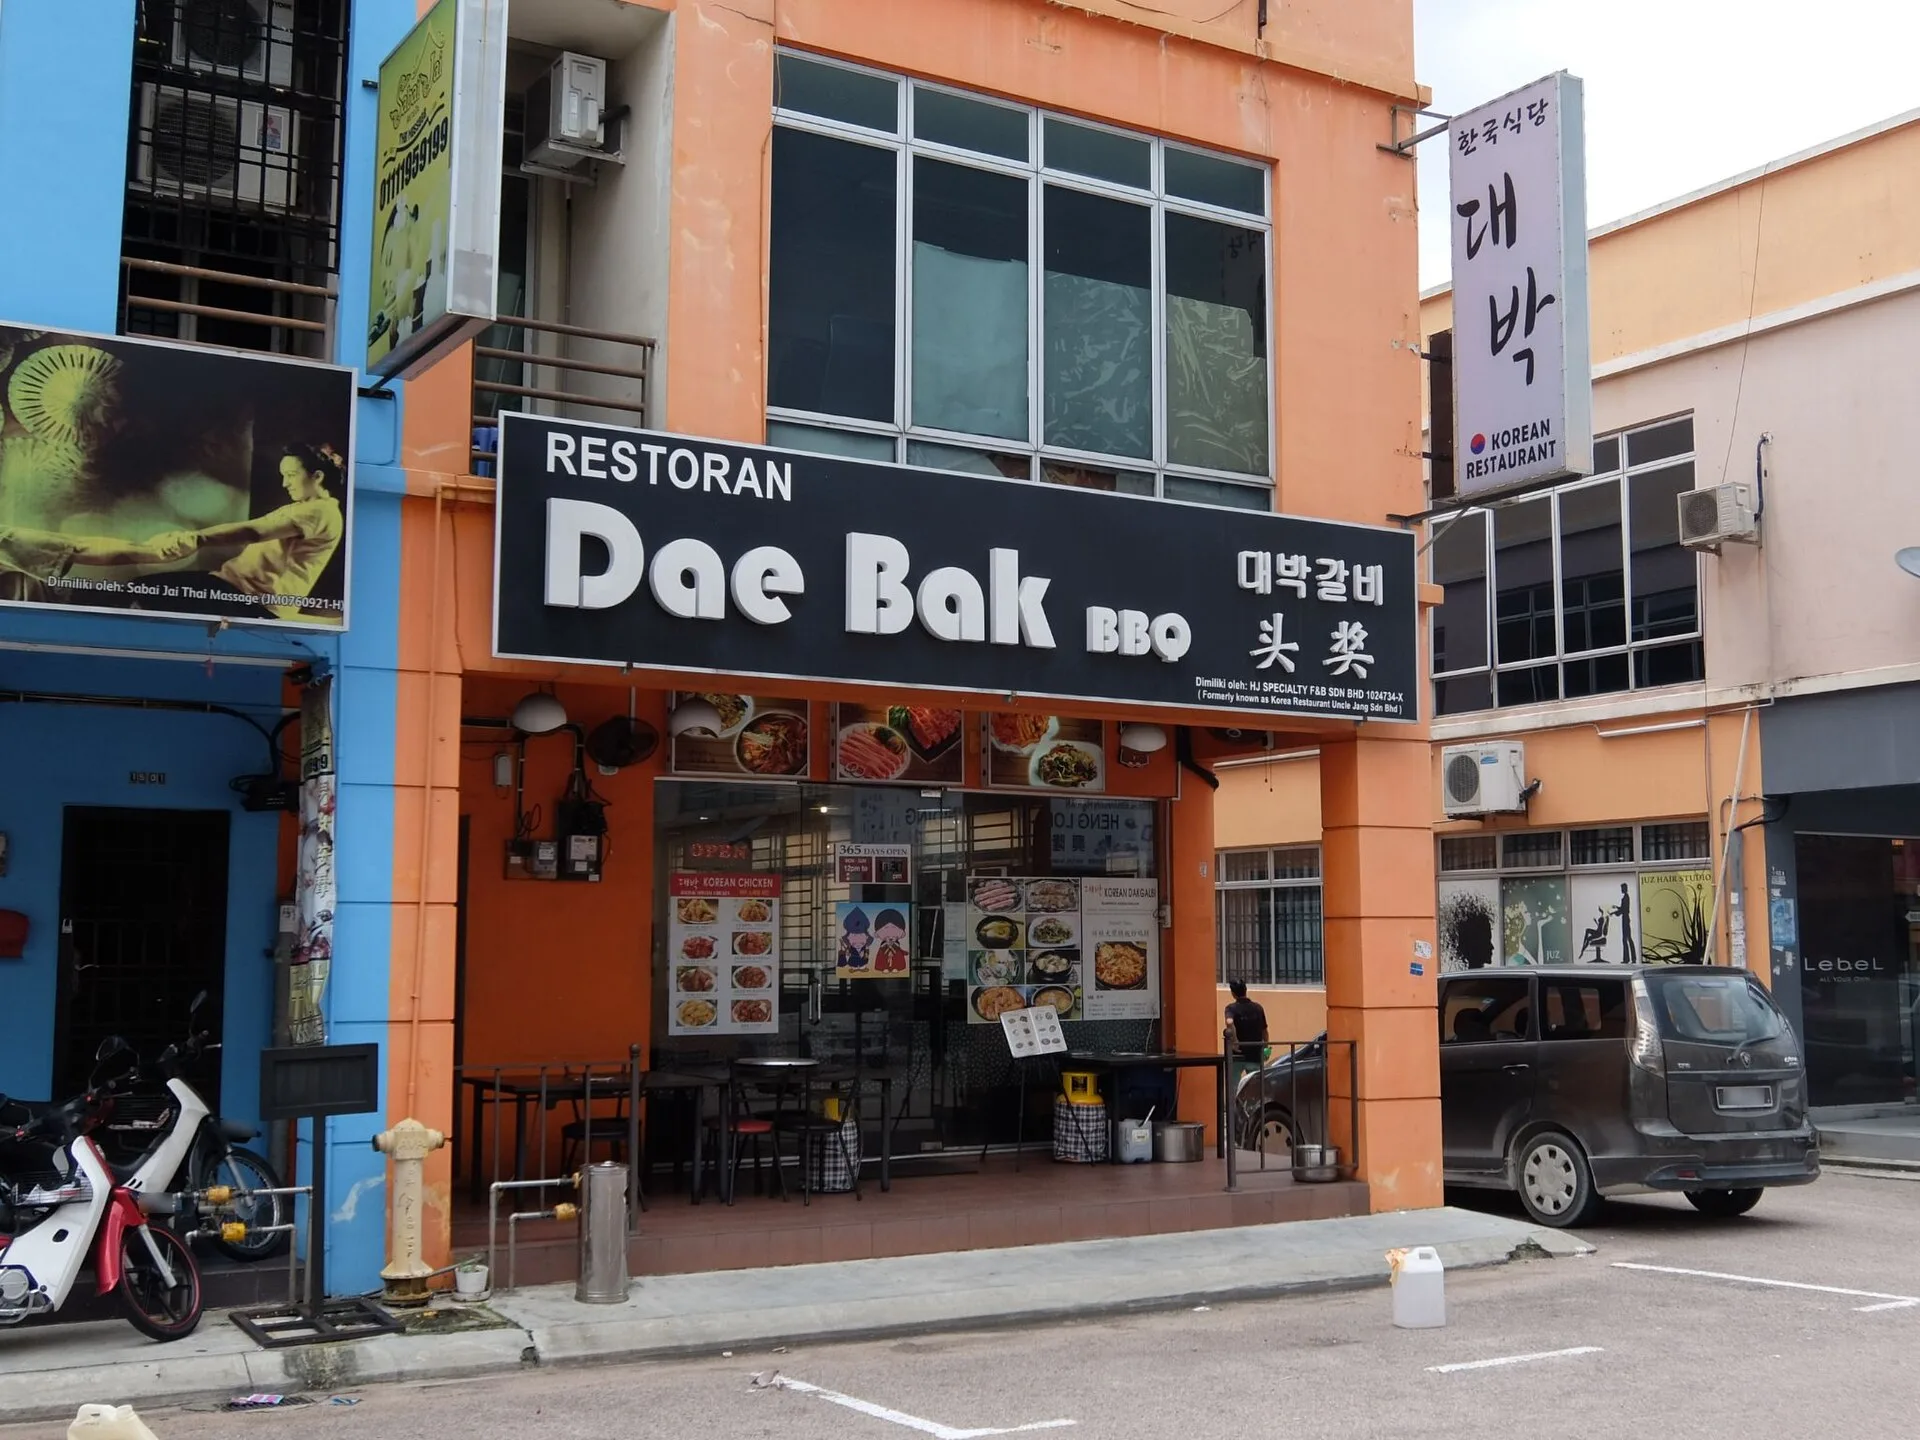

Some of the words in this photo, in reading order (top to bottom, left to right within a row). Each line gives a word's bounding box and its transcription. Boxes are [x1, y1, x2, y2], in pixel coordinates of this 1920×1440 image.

[1457, 98, 1549, 156] 한국식당
[1456, 171, 1556, 386] 대박
[1491, 418, 1551, 451] KOREAN
[546, 431, 792, 501] RESTORAN
[1466, 439, 1556, 480] RESTAURANT
[48, 576, 93, 590] Dimiliki
[95, 580, 125, 593] oleh:
[127, 582, 160, 596] Sabai
[162, 585, 179, 597] Jai
[182, 586, 207, 599] Thai
[209, 589, 259, 606] Massage
[544, 497, 805, 625] Dae
[844, 531, 1057, 650] Bak
[1086, 605, 1192, 663] BBQ
[1237, 549, 1384, 607] 대박갈비
[1195, 676, 1226, 689] Dimiliki
[1228, 680, 1248, 690] oleh:
[1250, 681, 1261, 691] HJ
[1263, 682, 1308, 695] SPECIALTY
[1309, 685, 1327, 697] F&B
[1328, 687, 1346, 698] SDN
[1347, 688, 1365, 699] BHD
[1366, 690, 1404, 702] 1024734-X
[1236, 692, 1259, 703] known
[1260, 695, 1269, 704] as
[1271, 695, 1292, 705] Korea
[1293, 697, 1331, 708] Restaurant
[1331, 700, 1351, 710] Uncle
[1352, 701, 1369, 713] Jang
[1370, 703, 1383, 712] Sdn
[840, 844, 862, 855] 365
[703, 877, 736, 888] KOREAN
[738, 878, 773, 888] CHICKEN
[1104, 887, 1128, 898] KOREAN
[1641, 876, 1655, 885] JUZ
[1656, 874, 1678, 883] HAIR
[1679, 873, 1712, 882] STUDIO
[1546, 950, 1560, 961] JUZ
